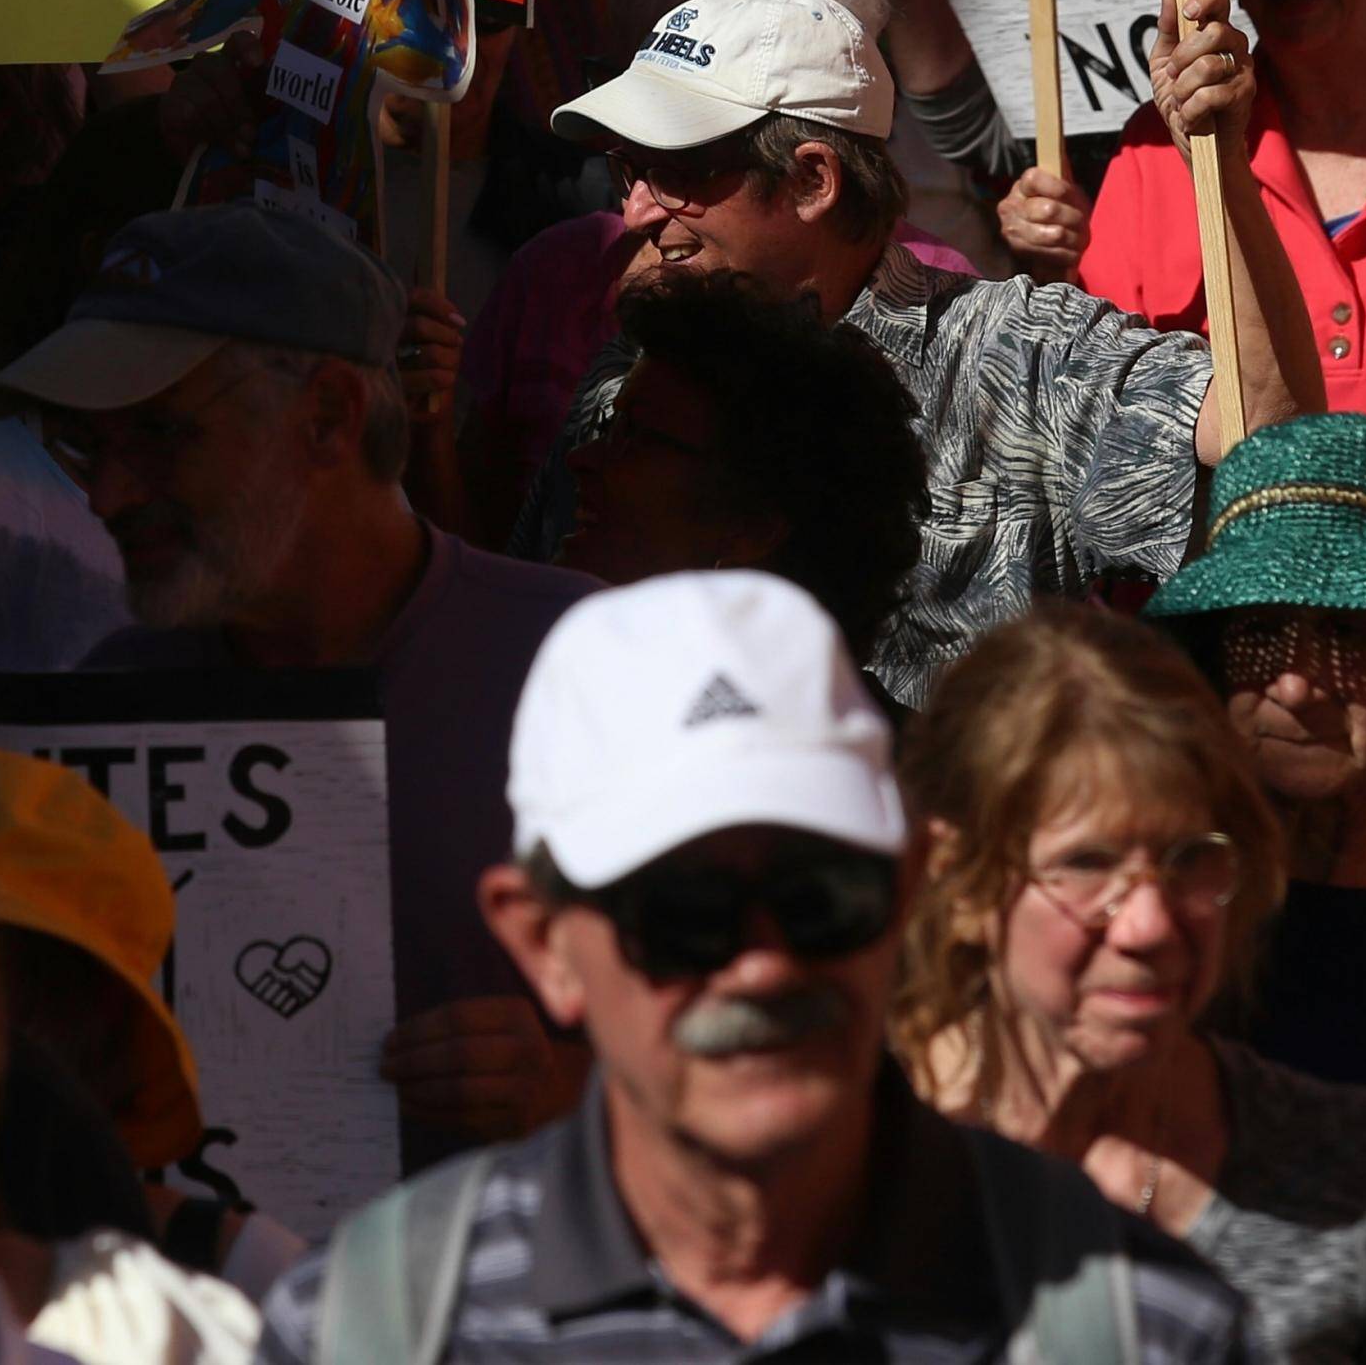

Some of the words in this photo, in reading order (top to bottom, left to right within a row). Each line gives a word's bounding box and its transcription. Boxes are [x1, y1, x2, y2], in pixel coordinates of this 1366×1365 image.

[653, 32, 716, 67] HEELS
[272, 66, 334, 112] world
[296, 150, 315, 187] is
